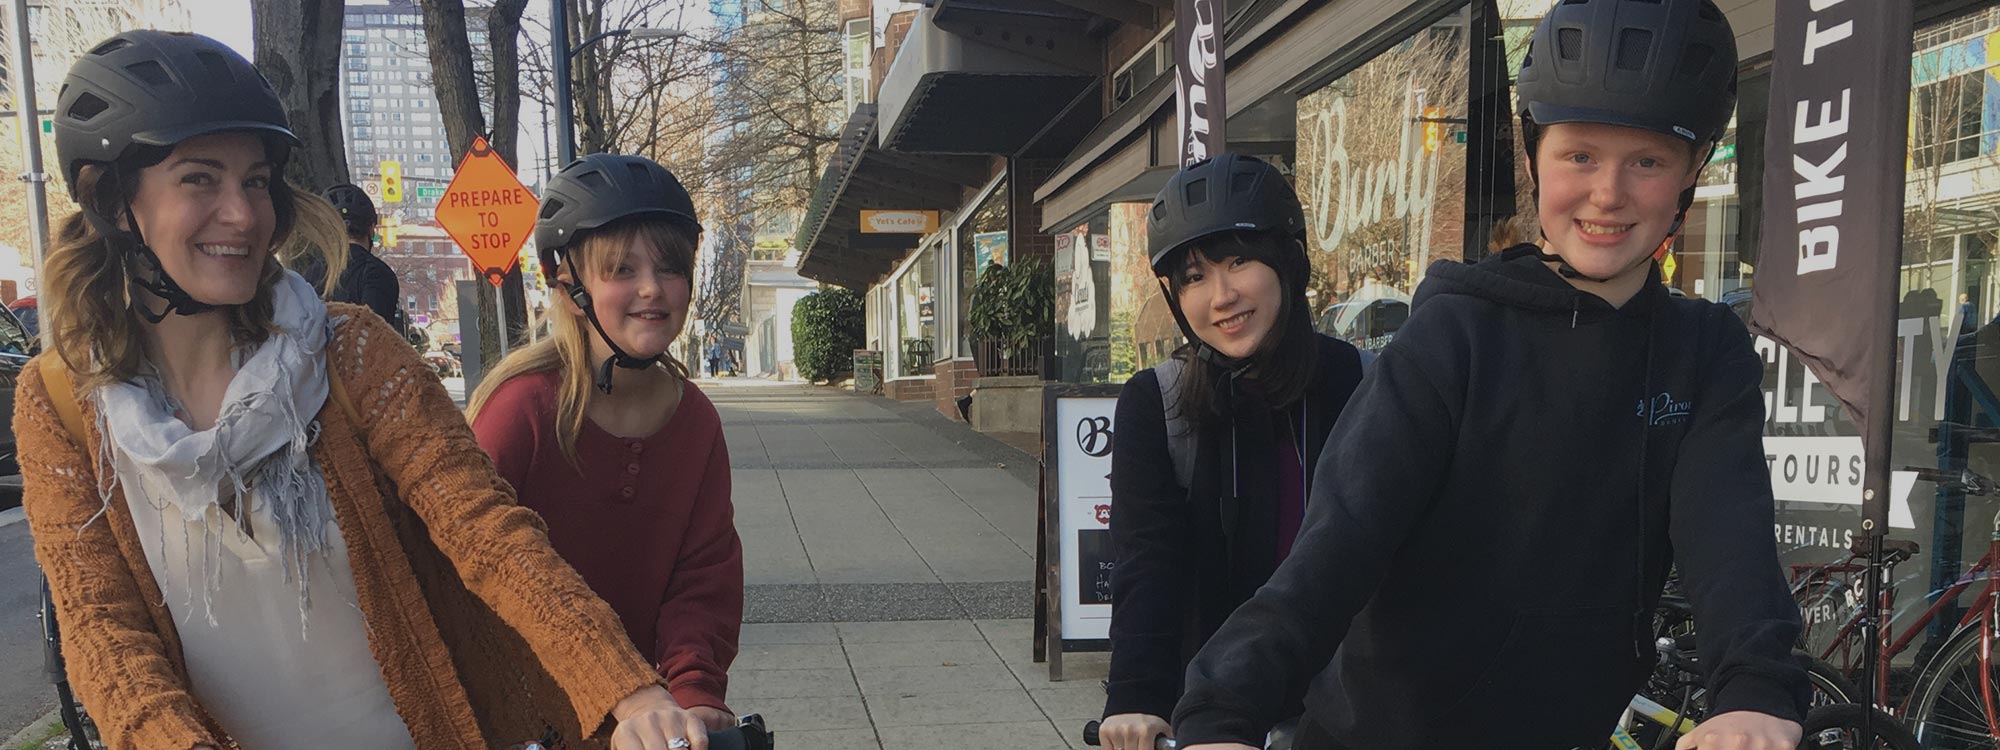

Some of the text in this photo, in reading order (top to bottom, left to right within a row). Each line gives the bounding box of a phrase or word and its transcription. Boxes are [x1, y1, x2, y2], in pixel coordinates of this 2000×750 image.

[1793, 0, 1853, 276] BIKE T
[451, 188, 523, 208] PREPARE
[1312, 69, 1440, 300] Burly
[478, 211, 499, 228] TO
[471, 232, 511, 250] STOP
[1349, 239, 1395, 274] BARBER
[1751, 332, 1826, 423] CLE
[1765, 454, 1861, 486] TOURS
[1774, 523, 1853, 550] RENTALS
